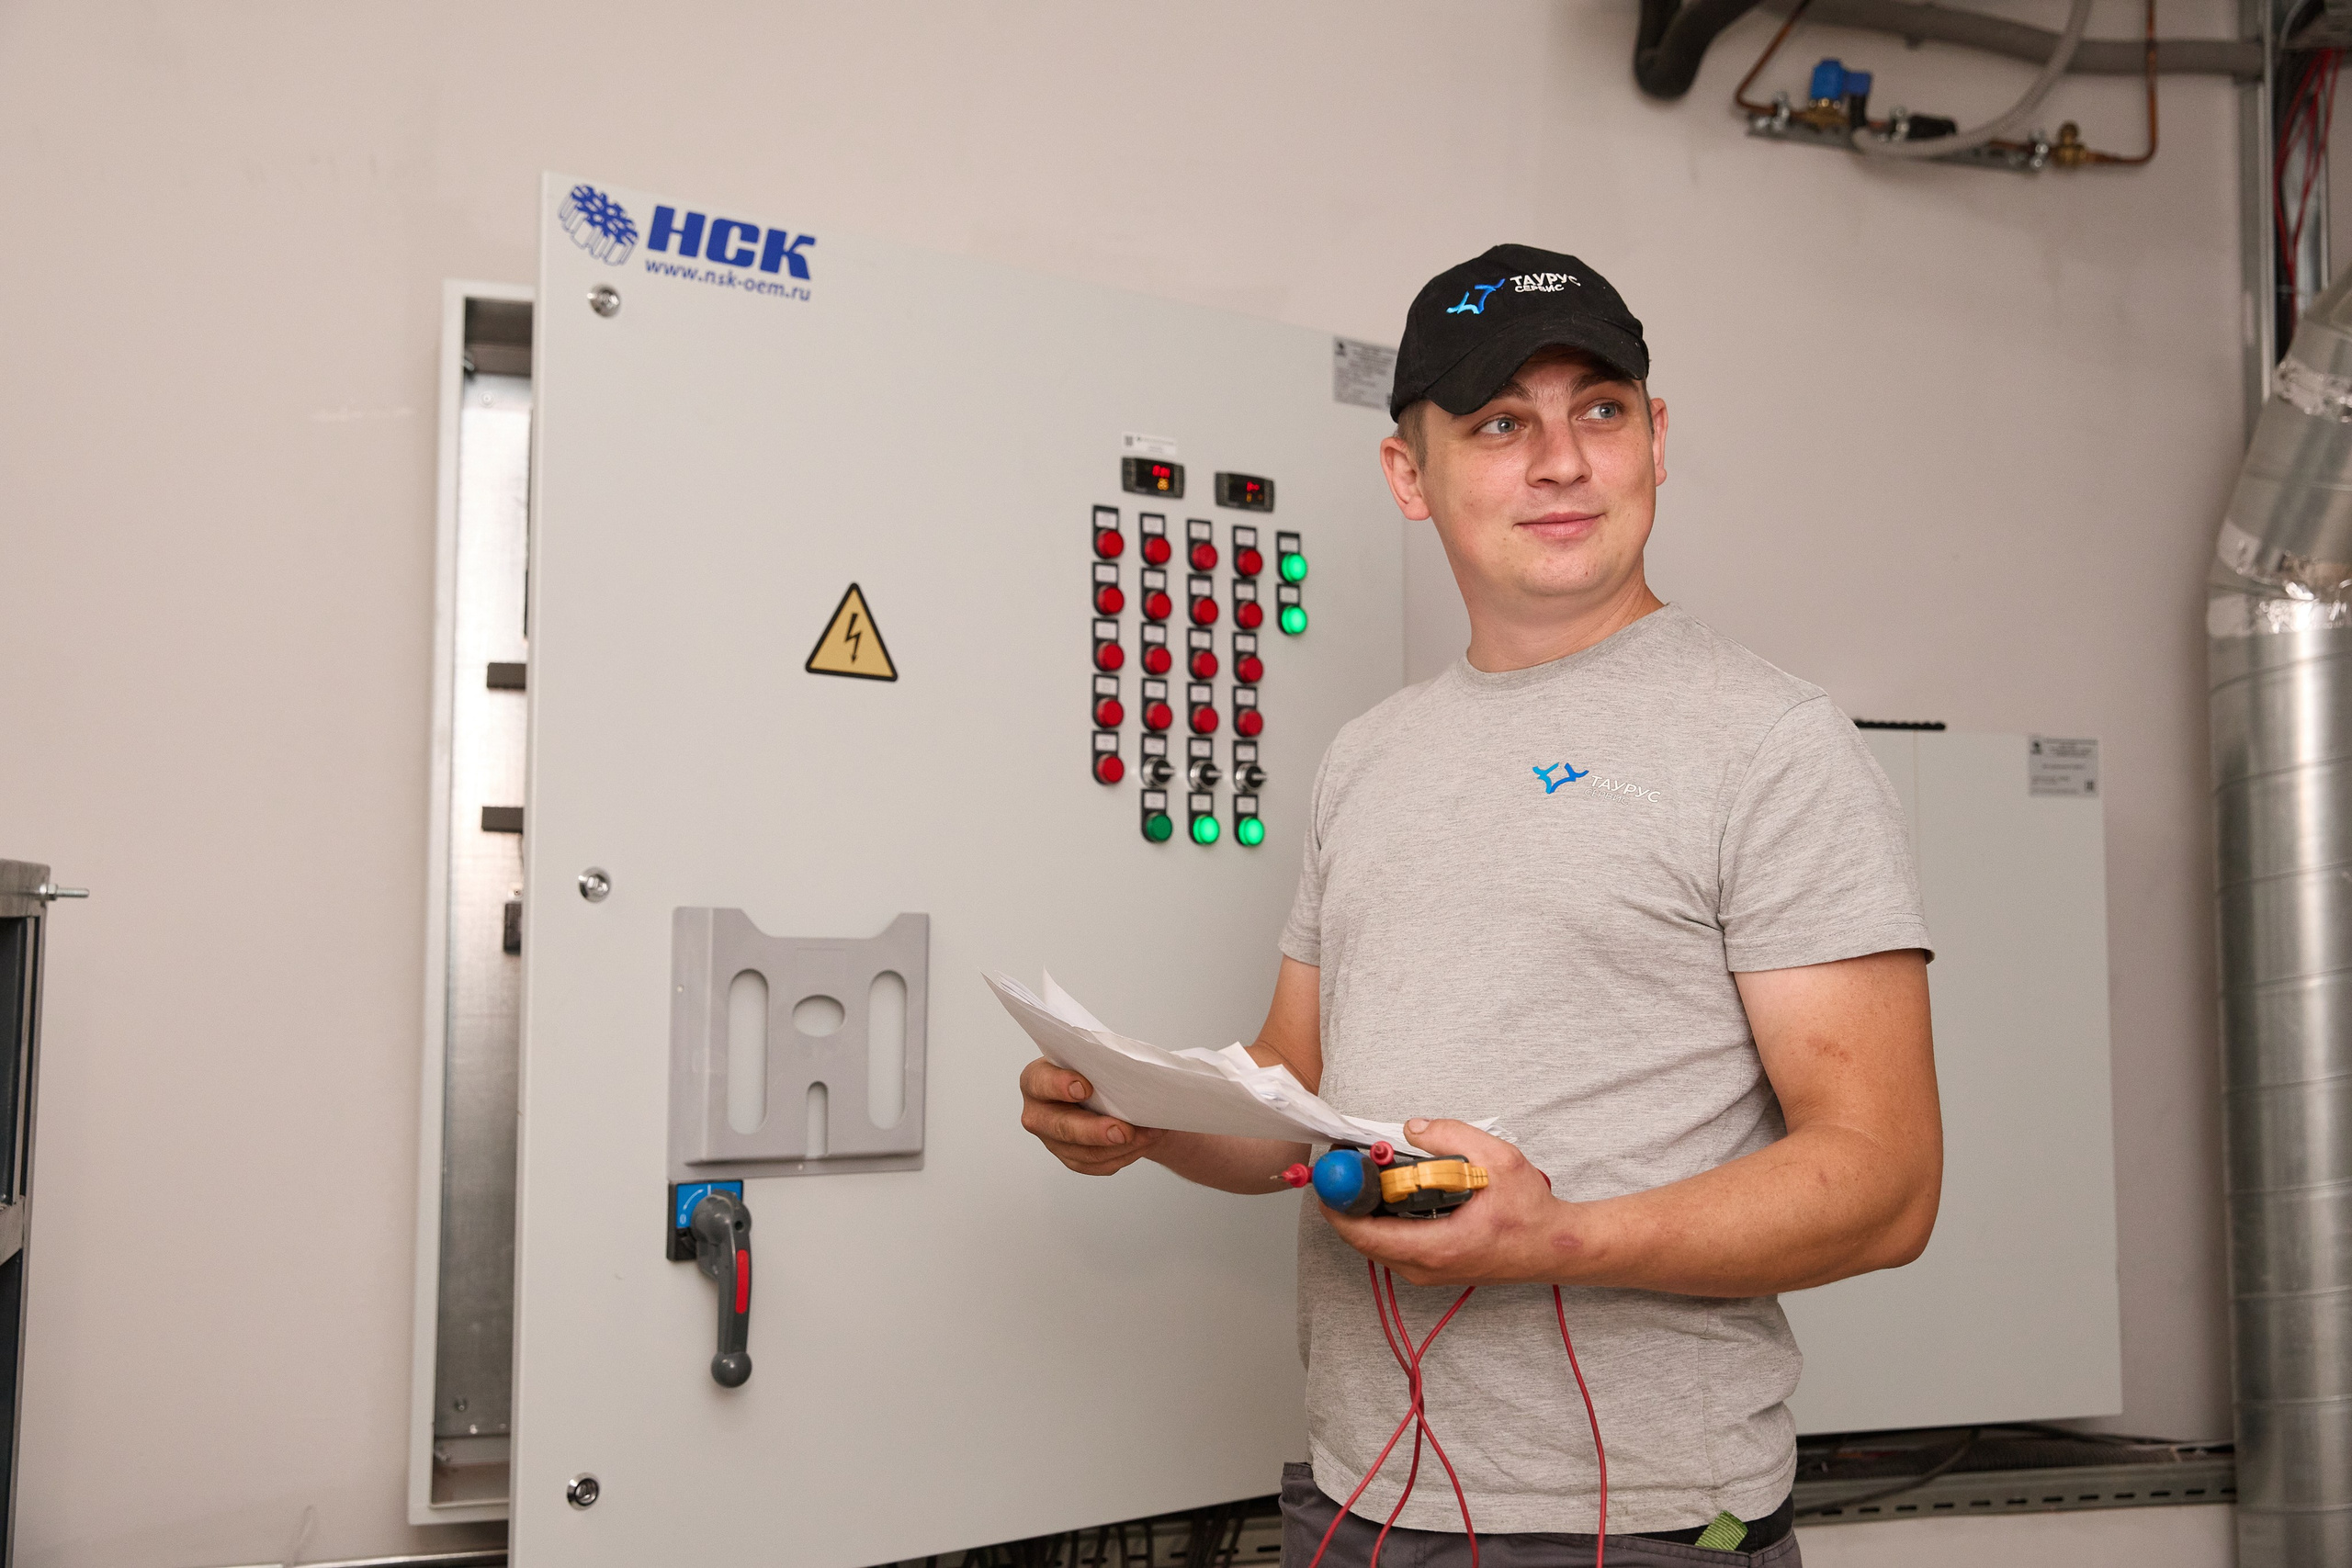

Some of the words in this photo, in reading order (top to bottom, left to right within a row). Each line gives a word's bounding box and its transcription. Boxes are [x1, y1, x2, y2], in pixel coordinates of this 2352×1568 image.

[648, 205, 815, 279] НСК
[645, 259, 810, 301] www.nsk-oem.ru
[1510, 273, 1581, 287] ТАУРУС
[1515, 284, 1565, 292] СЕРВИС
[1585, 788, 1629, 806] СЕРВИС
[1591, 775, 1661, 803] ТАУРУС
